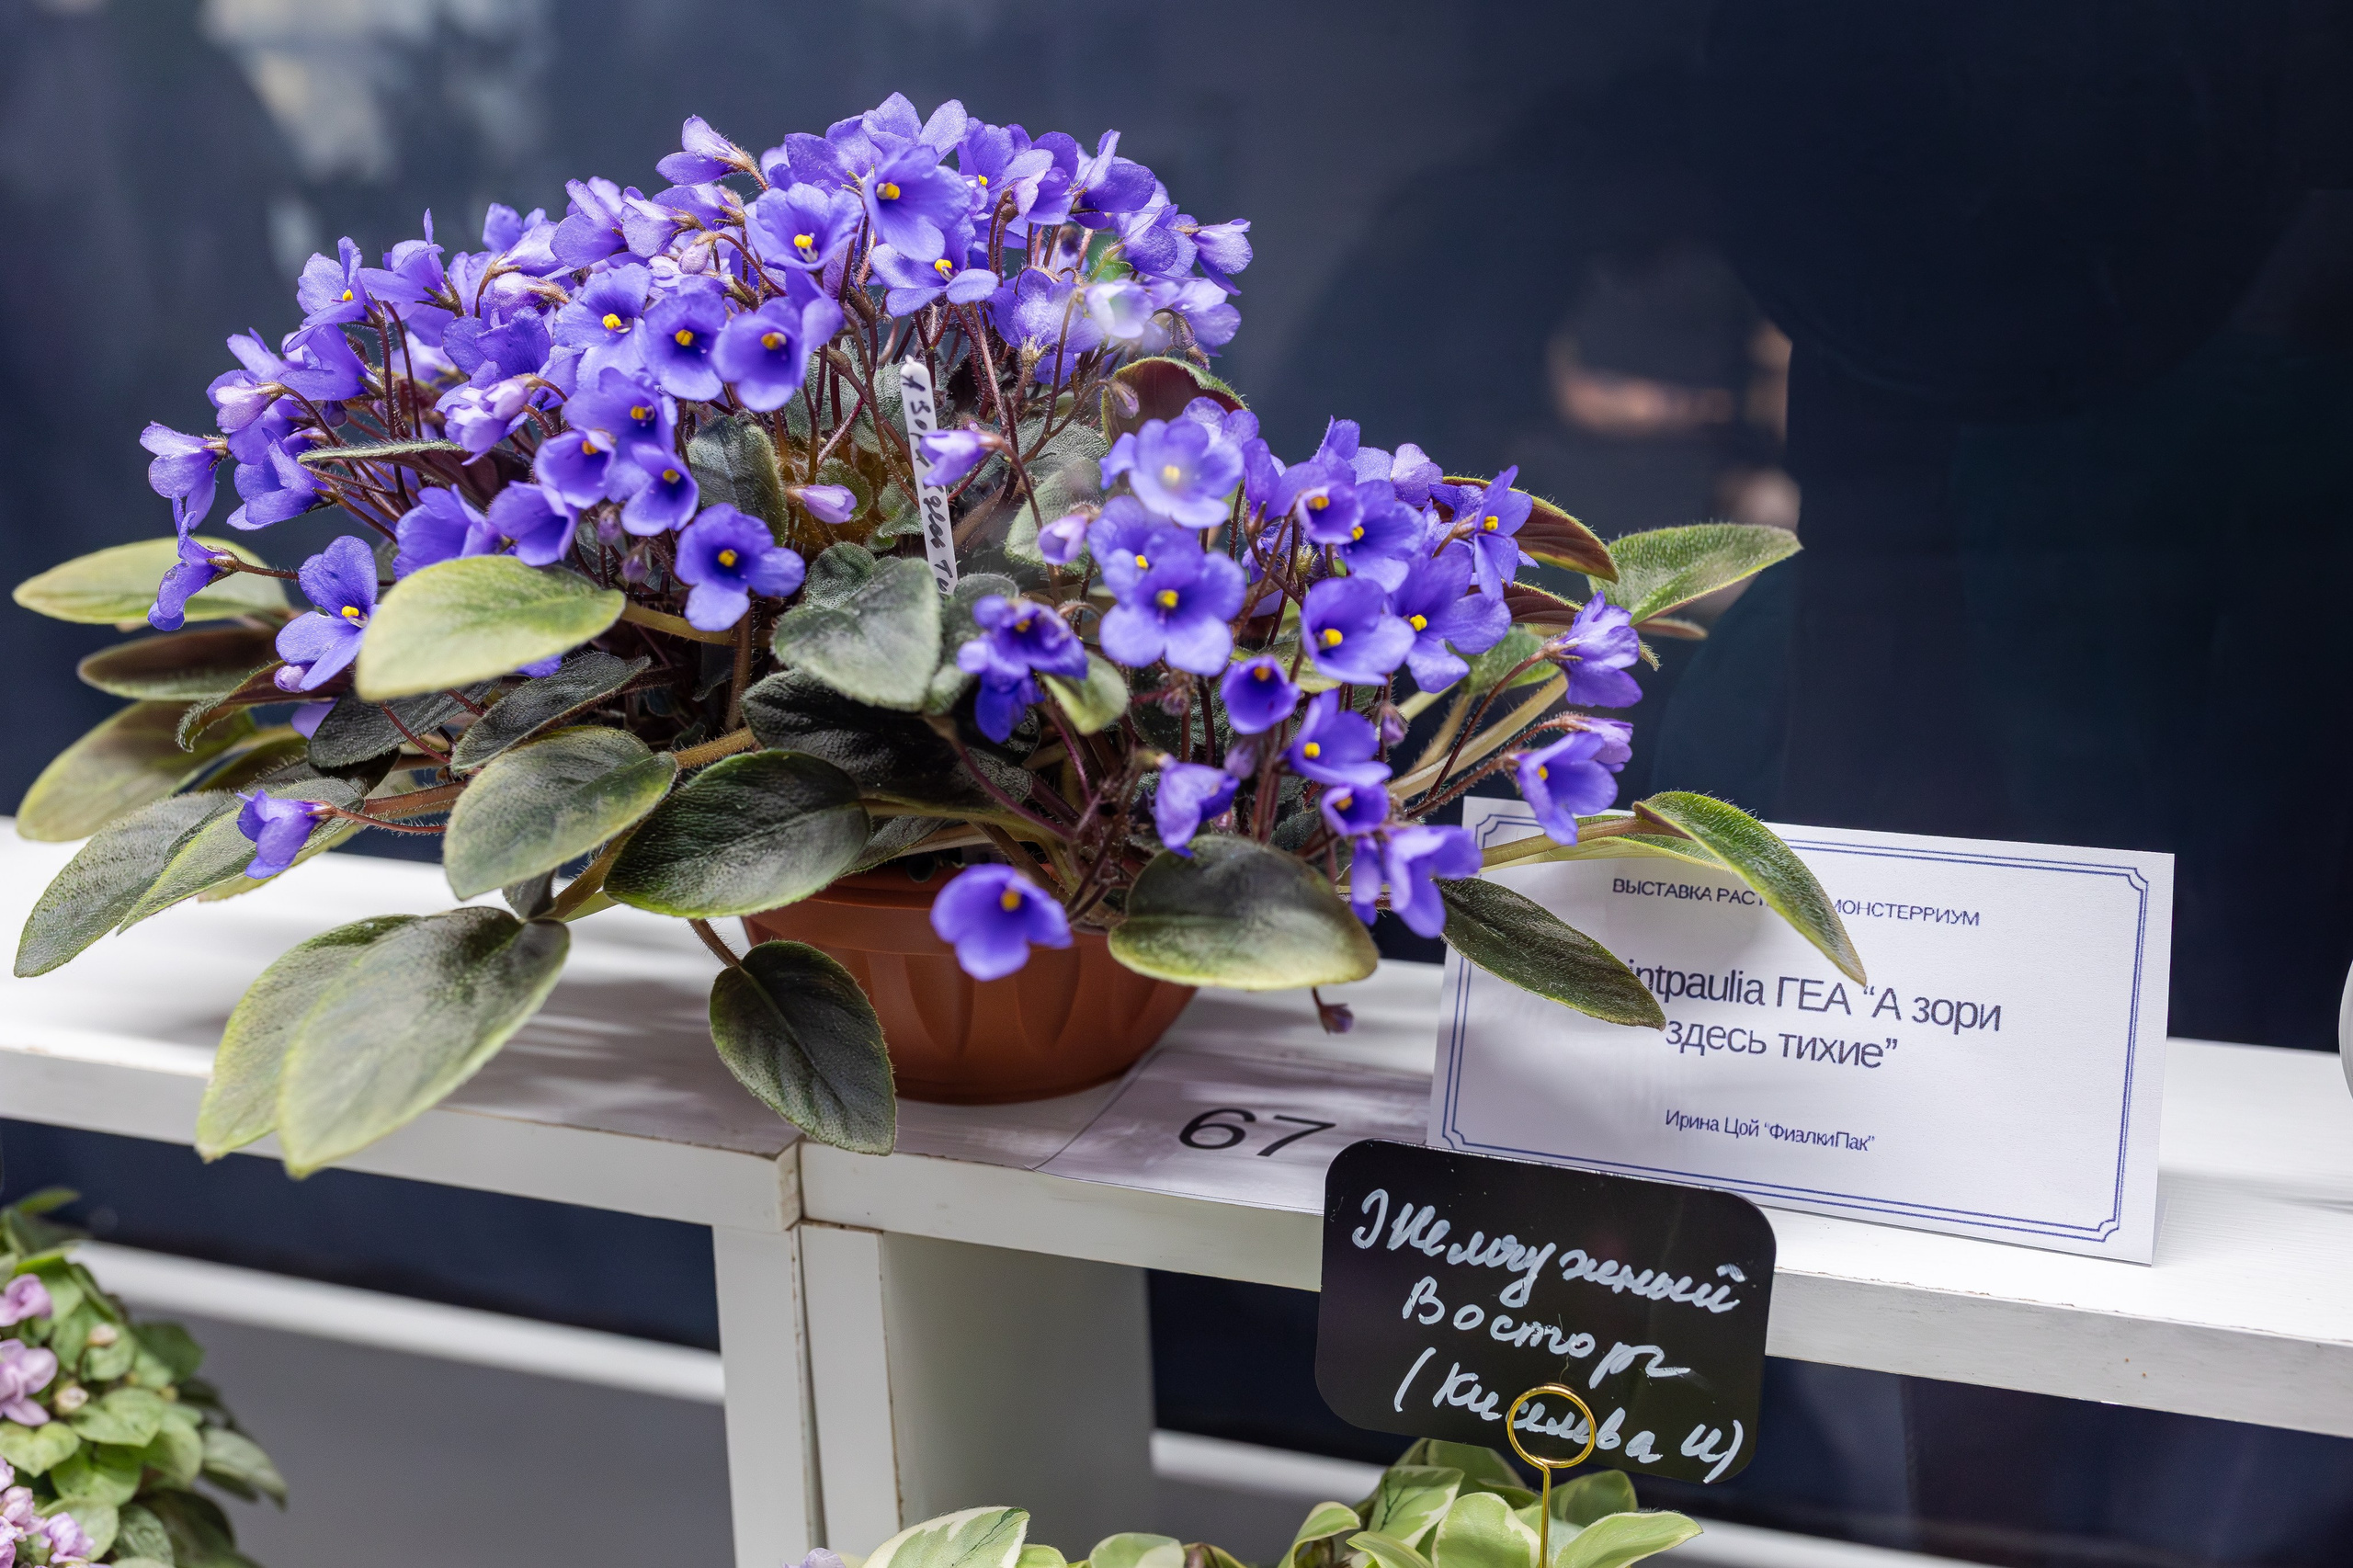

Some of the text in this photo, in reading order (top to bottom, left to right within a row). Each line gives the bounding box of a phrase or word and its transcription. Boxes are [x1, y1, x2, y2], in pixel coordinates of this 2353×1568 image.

[1612, 877, 1712, 902] ВЫСТАВКА
[1776, 975, 1852, 1016] ГЕА
[1911, 995, 2002, 1035] зори
[1665, 1019, 1898, 1069] здесь тихие”
[1178, 1107, 1337, 1157] 67
[1665, 1108, 1721, 1132] Ирина
[1723, 1116, 1759, 1139] Цой
[1402, 1275, 1691, 1390] Восторг
